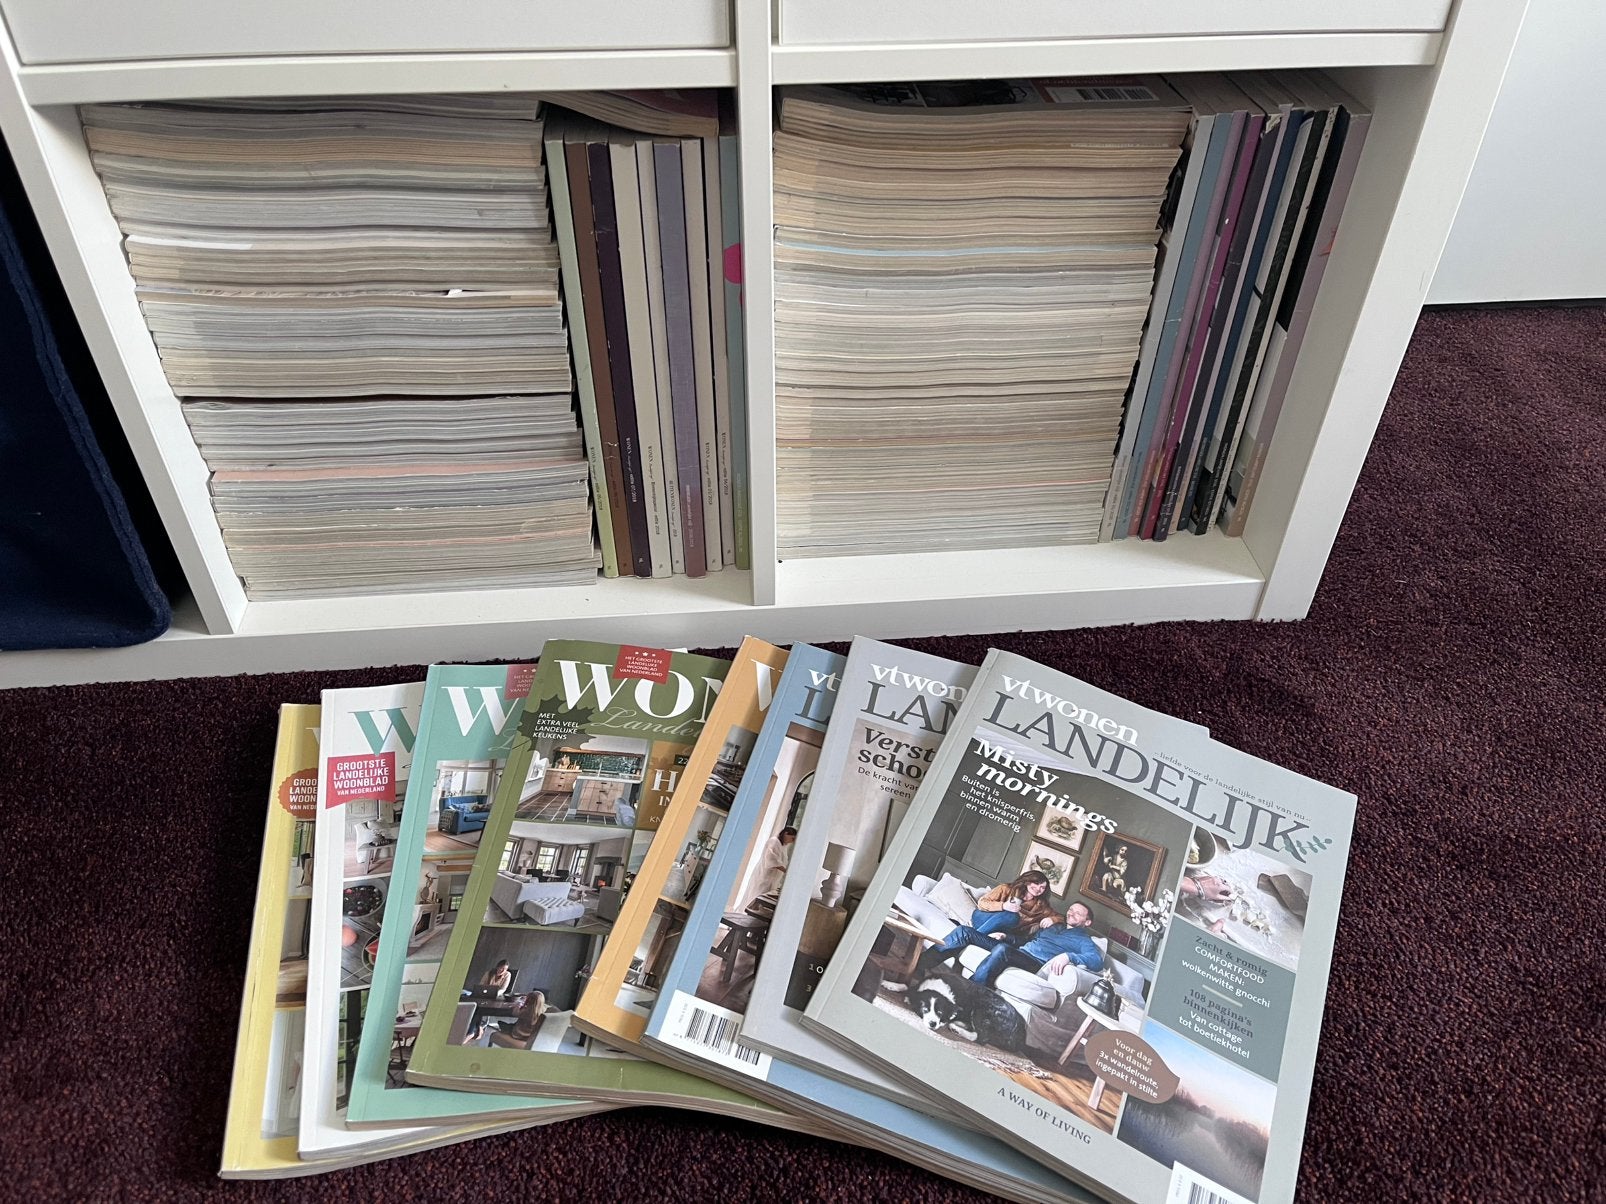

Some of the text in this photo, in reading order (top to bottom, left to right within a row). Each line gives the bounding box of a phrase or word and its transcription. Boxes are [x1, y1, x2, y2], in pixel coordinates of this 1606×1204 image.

[1002, 674, 1138, 746] vtwonen
[533, 732, 567, 740] KEUKENS
[535, 726, 578, 734] LANDELIJKE
[334, 768, 389, 780] LANDELIJKE
[337, 759, 386, 771] GROOTSTE
[858, 749, 927, 779] scho
[858, 767, 870, 776] De
[873, 771, 902, 786] kracht
[974, 739, 1059, 789] Misty
[983, 691, 1309, 863] LANDELIJK
[334, 777, 388, 789] WOONBLAD
[350, 786, 385, 794] NEDERLAND
[880, 785, 911, 798] sereen
[962, 775, 1000, 796] Buiten is
[976, 763, 1118, 834] mornings
[1184, 765, 1201, 776] voor
[1204, 774, 1213, 783] de
[1216, 779, 1256, 800] landelijke
[1275, 805, 1291, 815] van
[960, 790, 1019, 821] binnen warm
[966, 803, 1020, 833] en dromerig
[970, 787, 1035, 821] het knisperfris,
[1195, 946, 1264, 984] COMFORTFOOD
[1196, 936, 1267, 977] Zacht & romig
[1182, 960, 1271, 1008] wolkenwitte gnocchi
[1209, 964, 1245, 986] MAKEN:
[1183, 996, 1253, 1038] binnenkijken
[1190, 989, 1252, 1026] 108 pagina's
[1179, 1016, 1250, 1059] tot boetiekhotel
[1190, 1011, 1242, 1044] Van cottage
[1113, 1049, 1150, 1072] en dauw
[1115, 1039, 1152, 1066] Voor dag
[1096, 1059, 1158, 1098] ingepakt in stilte
[1099, 1051, 1159, 1089] 3x wandelroute,
[998, 1087, 1091, 1145] A WAY OF LIVING
